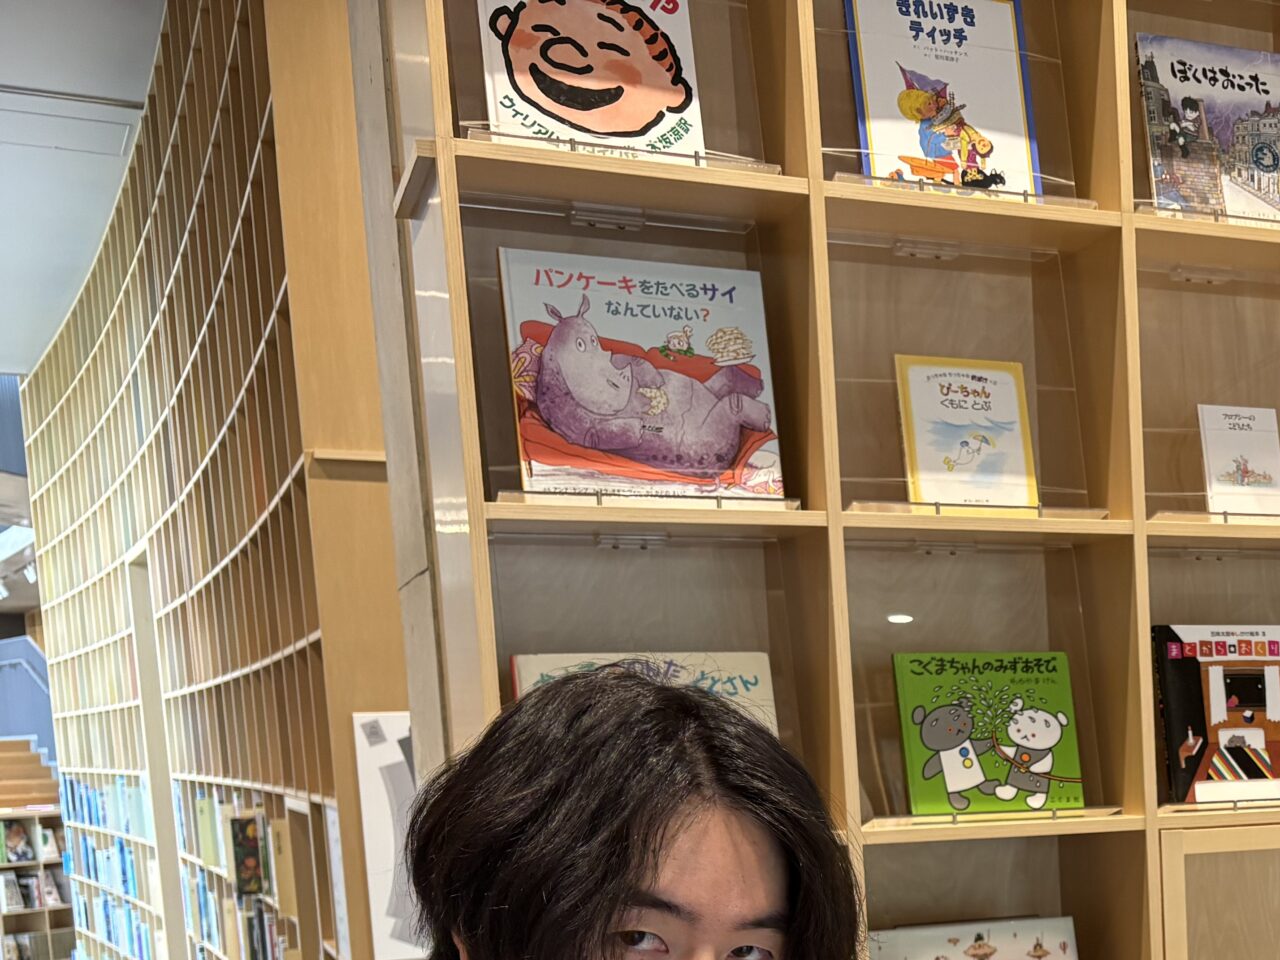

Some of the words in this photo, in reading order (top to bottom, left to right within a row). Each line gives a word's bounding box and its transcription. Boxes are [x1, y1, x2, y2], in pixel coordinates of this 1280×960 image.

[896, 0, 976, 27] きれいずき
[909, 20, 968, 48] ティッチ
[1170, 59, 1271, 96] ぼくはおこった
[534, 269, 737, 304] パンケーキをたべるサイ
[605, 300, 710, 322] なんていない?
[940, 398, 969, 410] くもに
[971, 400, 992, 412] とぶ
[909, 656, 1058, 676] こぐまちゃんのみずあそび
